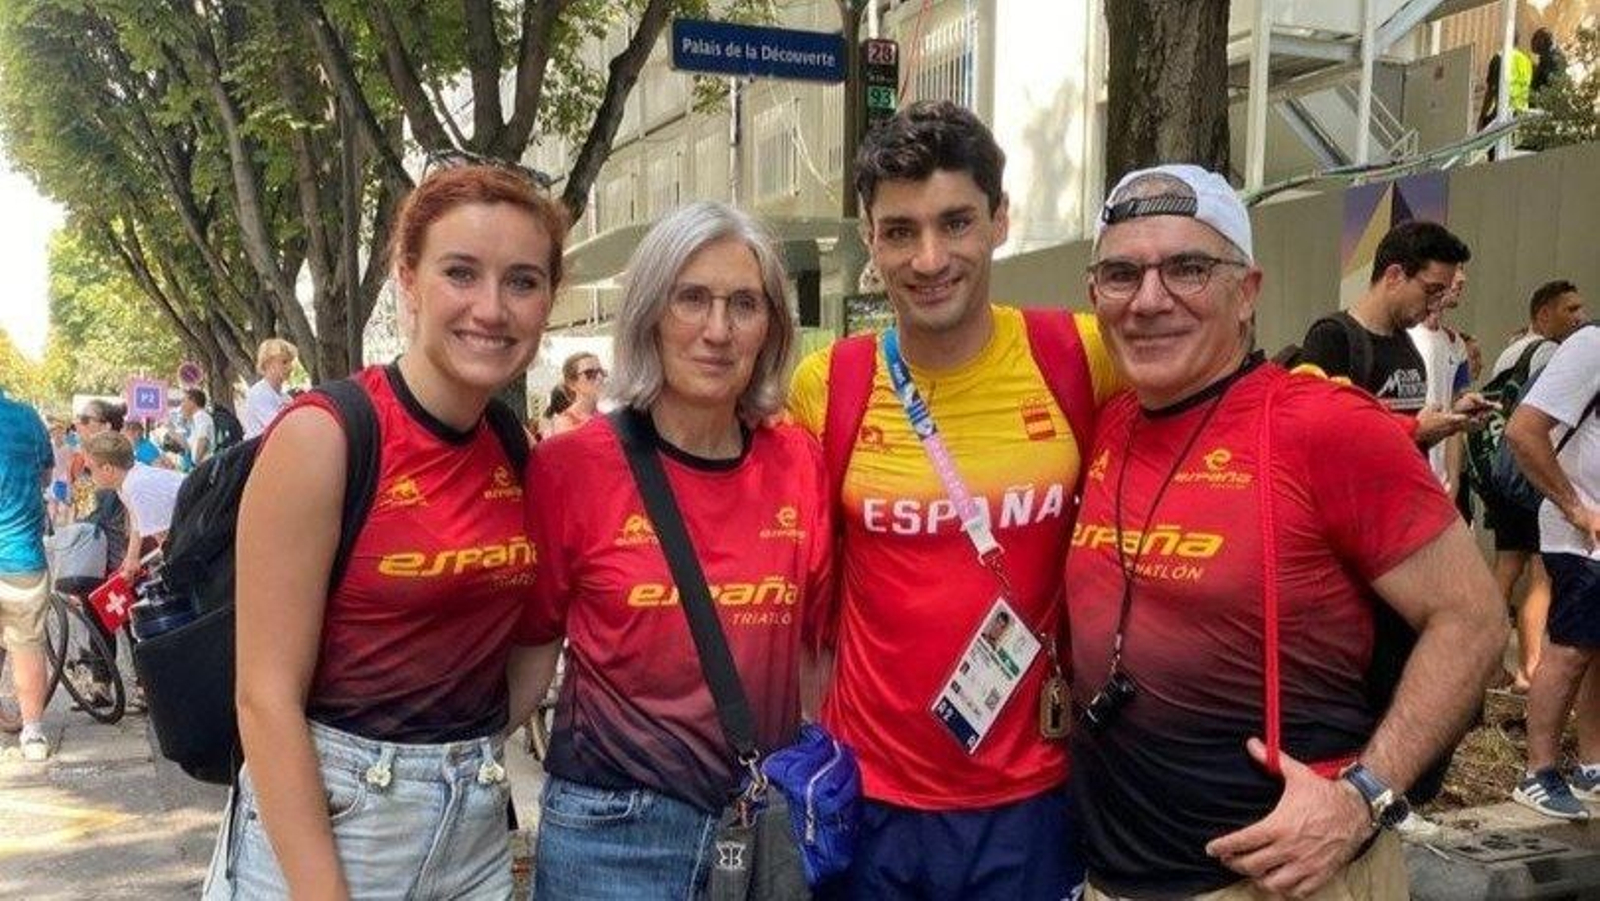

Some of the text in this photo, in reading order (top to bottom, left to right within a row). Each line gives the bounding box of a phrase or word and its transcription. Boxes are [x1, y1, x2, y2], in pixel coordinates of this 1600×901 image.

[682, 38, 836, 67] Palais de la Découverte
[870, 88, 892, 107] 93
[378, 535, 538, 577] españ
